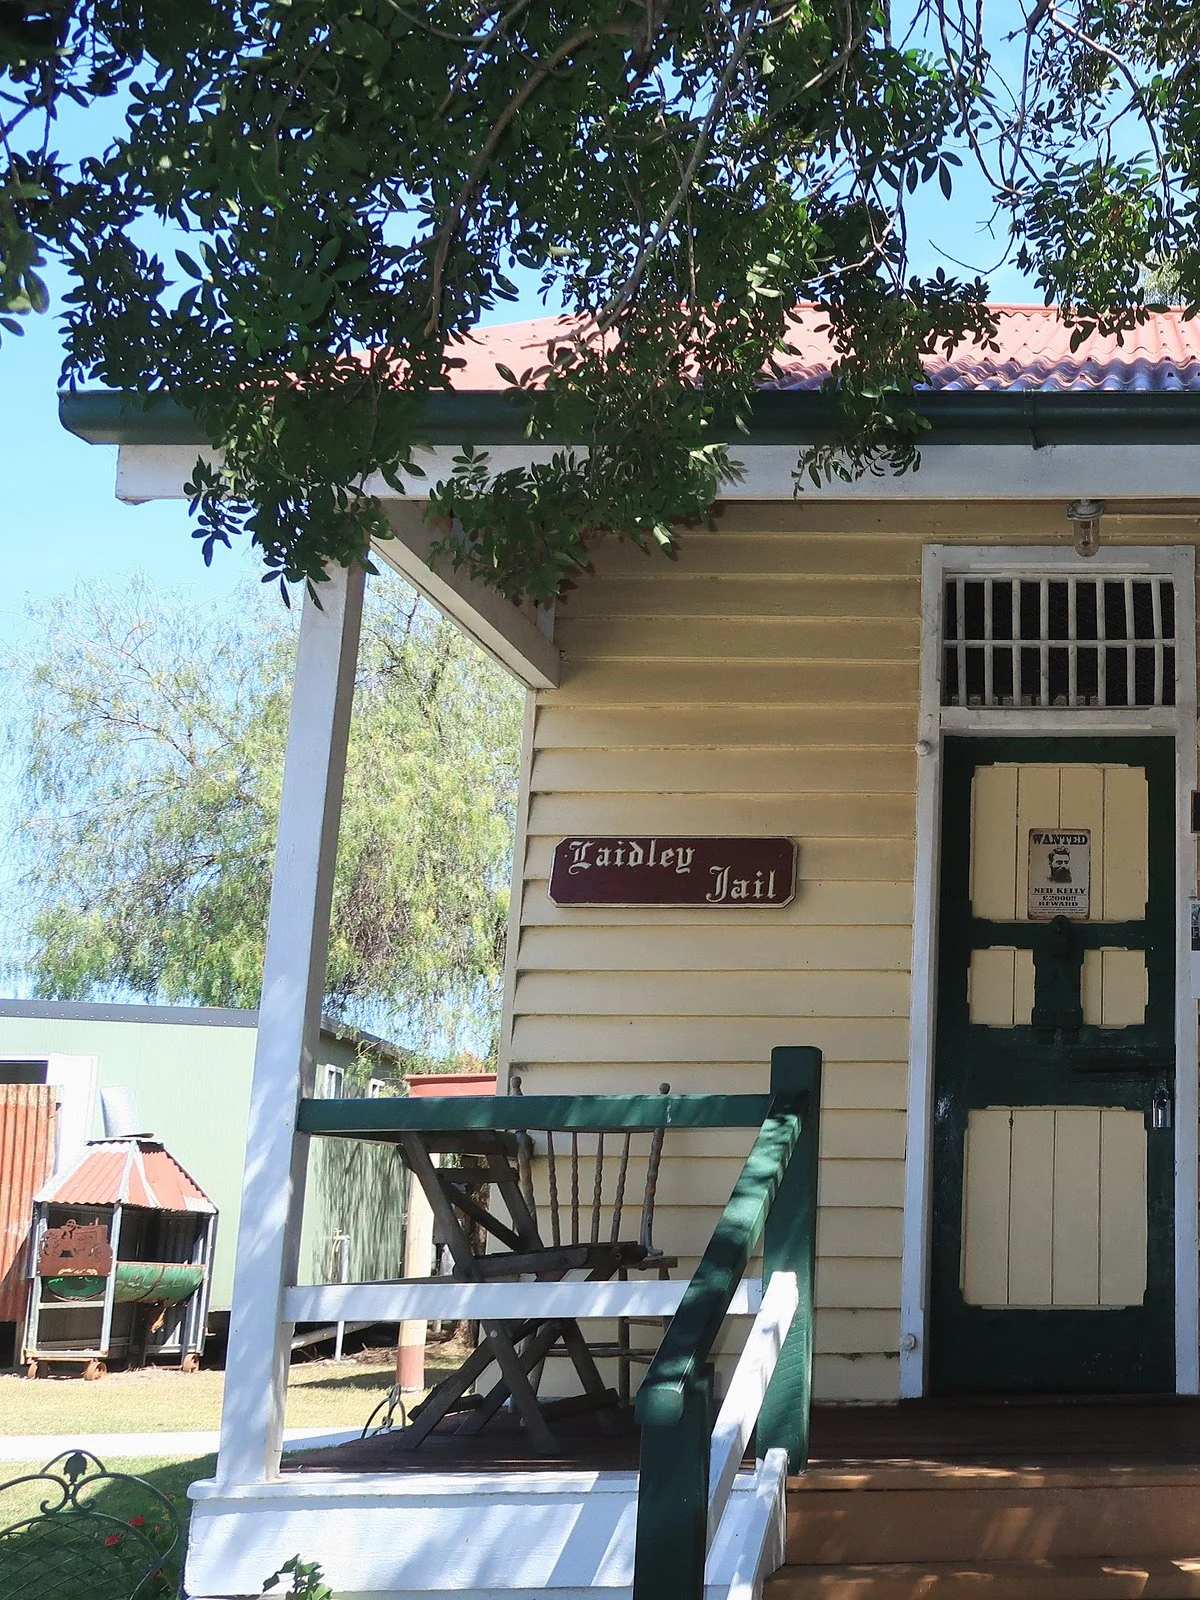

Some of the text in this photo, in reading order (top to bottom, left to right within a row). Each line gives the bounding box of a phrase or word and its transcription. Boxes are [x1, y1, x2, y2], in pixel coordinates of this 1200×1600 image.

[568, 839, 695, 875] Laidley
[1033, 834, 1088, 845] WANTED
[706, 865, 776, 902] Jail
